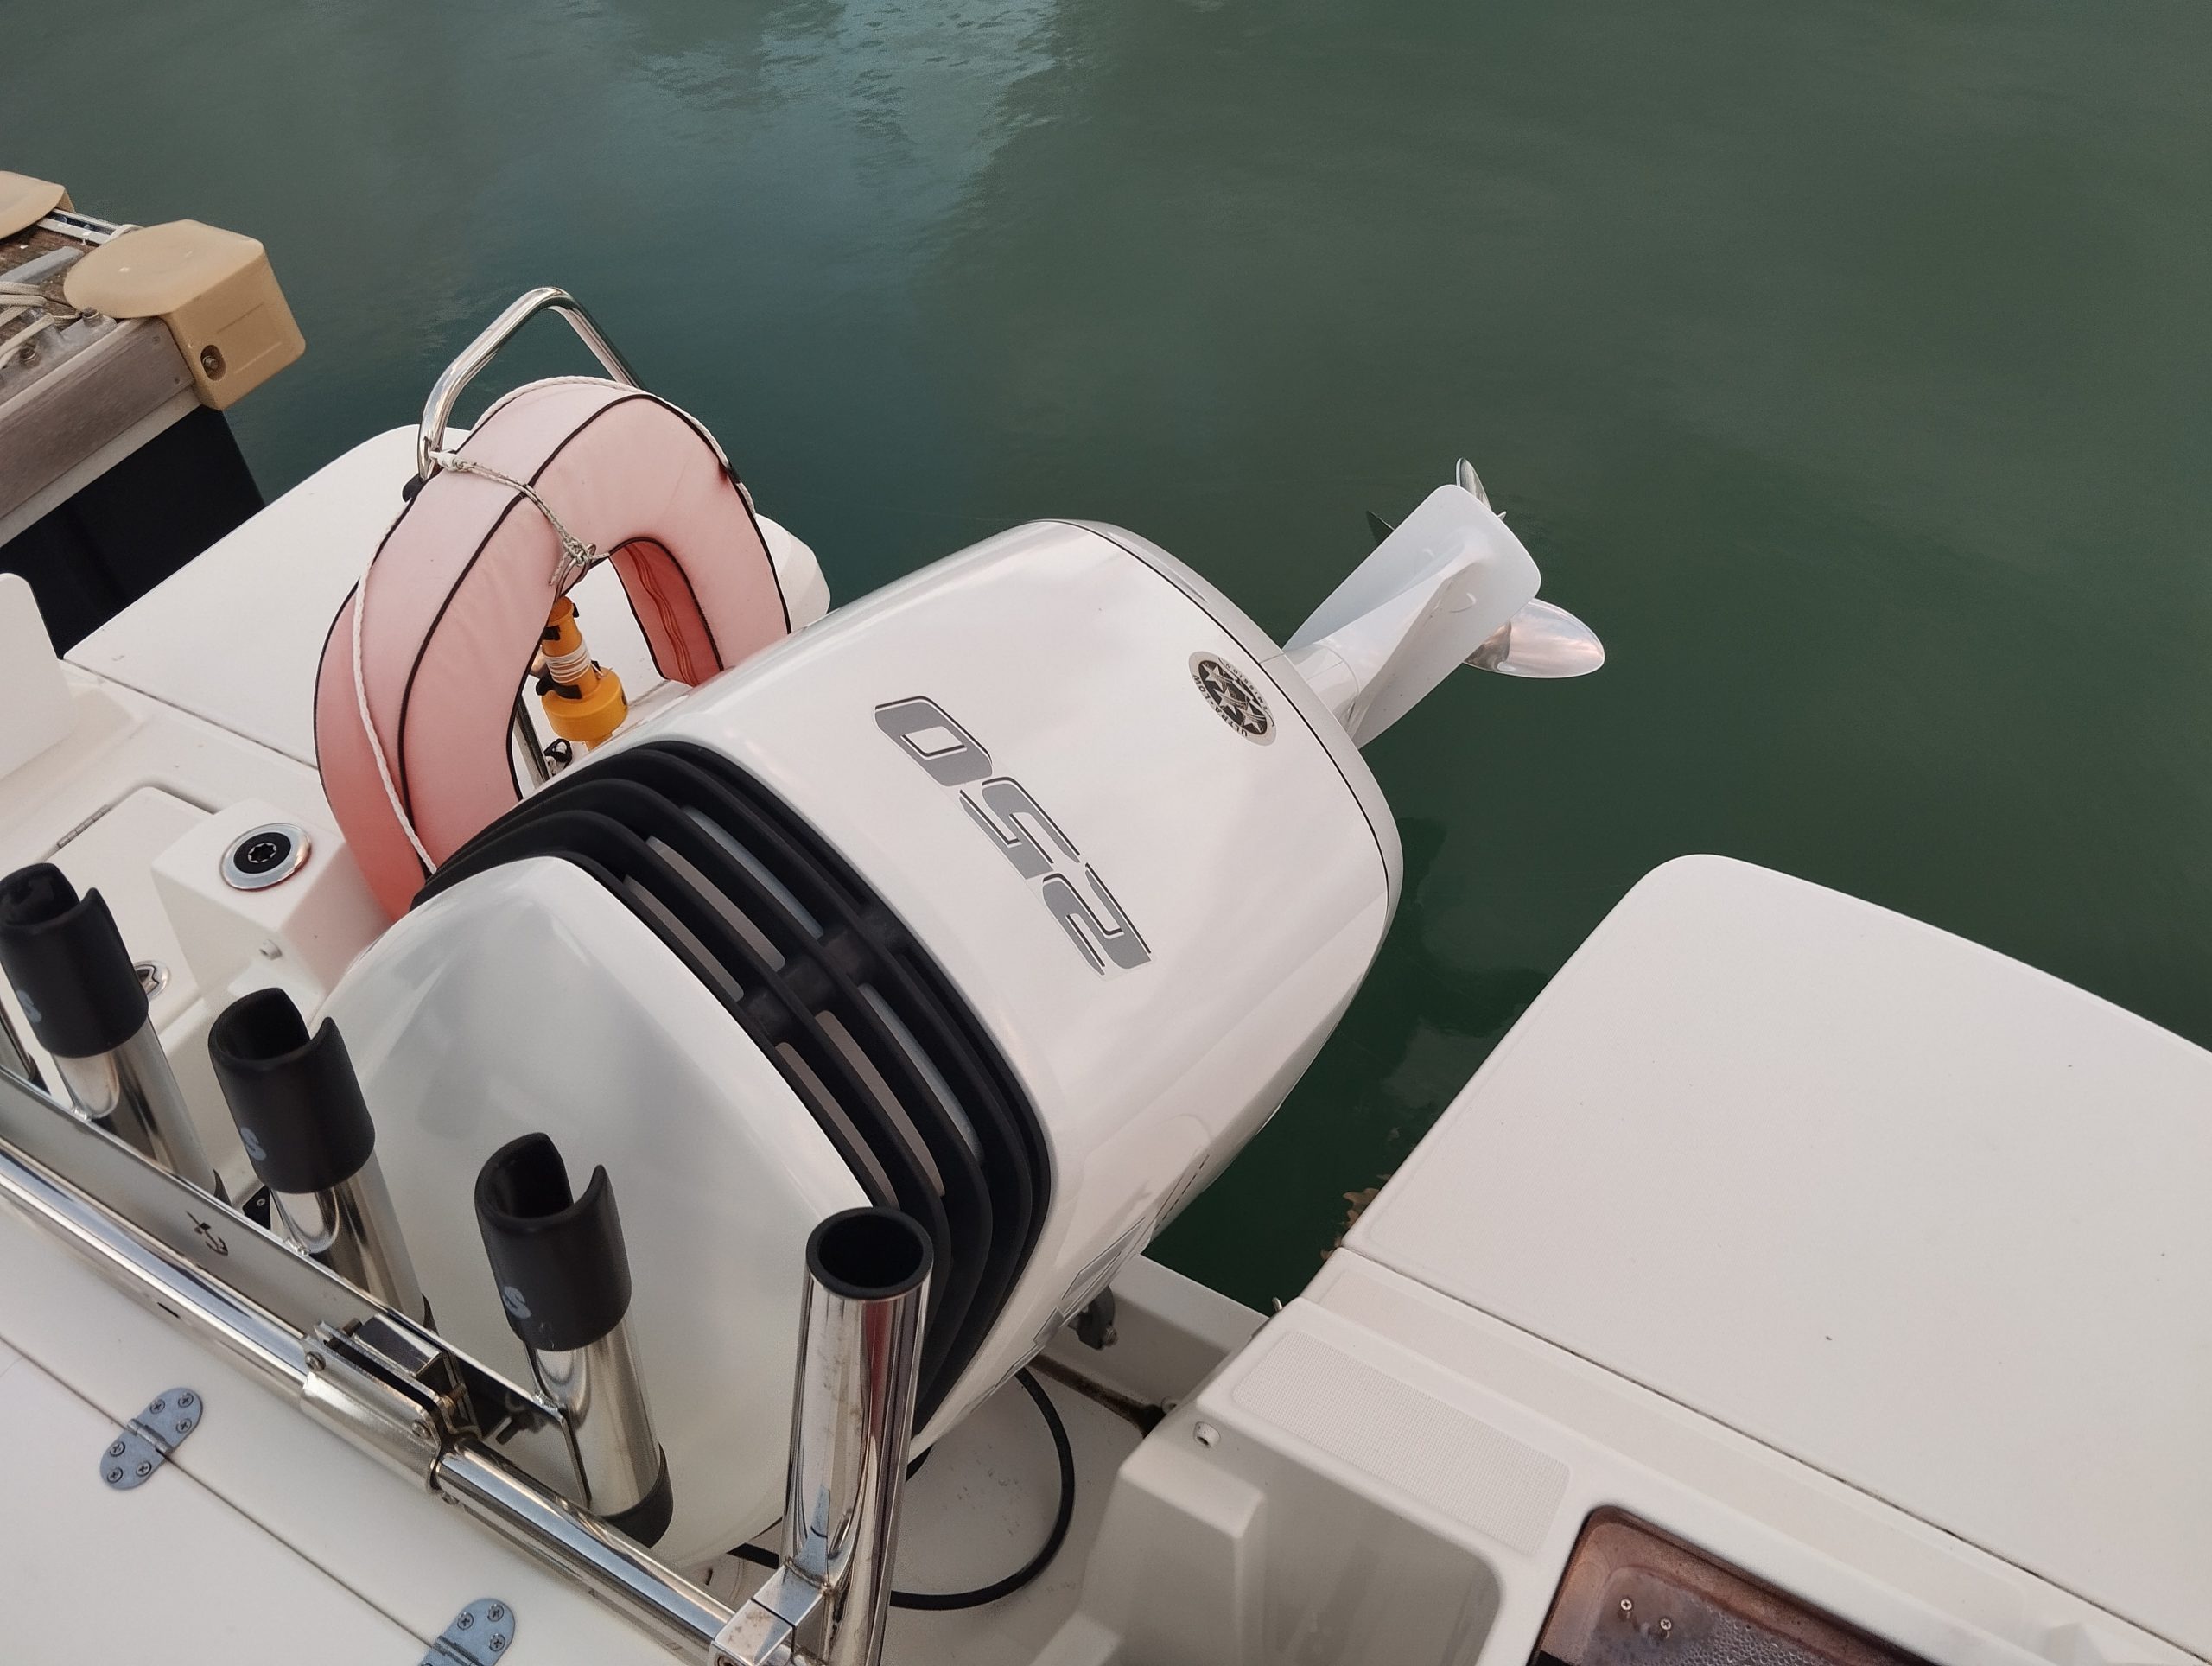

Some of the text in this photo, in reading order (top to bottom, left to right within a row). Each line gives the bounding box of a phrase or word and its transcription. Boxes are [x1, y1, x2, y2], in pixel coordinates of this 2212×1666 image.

[1192, 674, 1248, 737] ULTRA LOW
[1225, 663, 1268, 710] EMISSION
[874, 696, 1152, 976] 250
